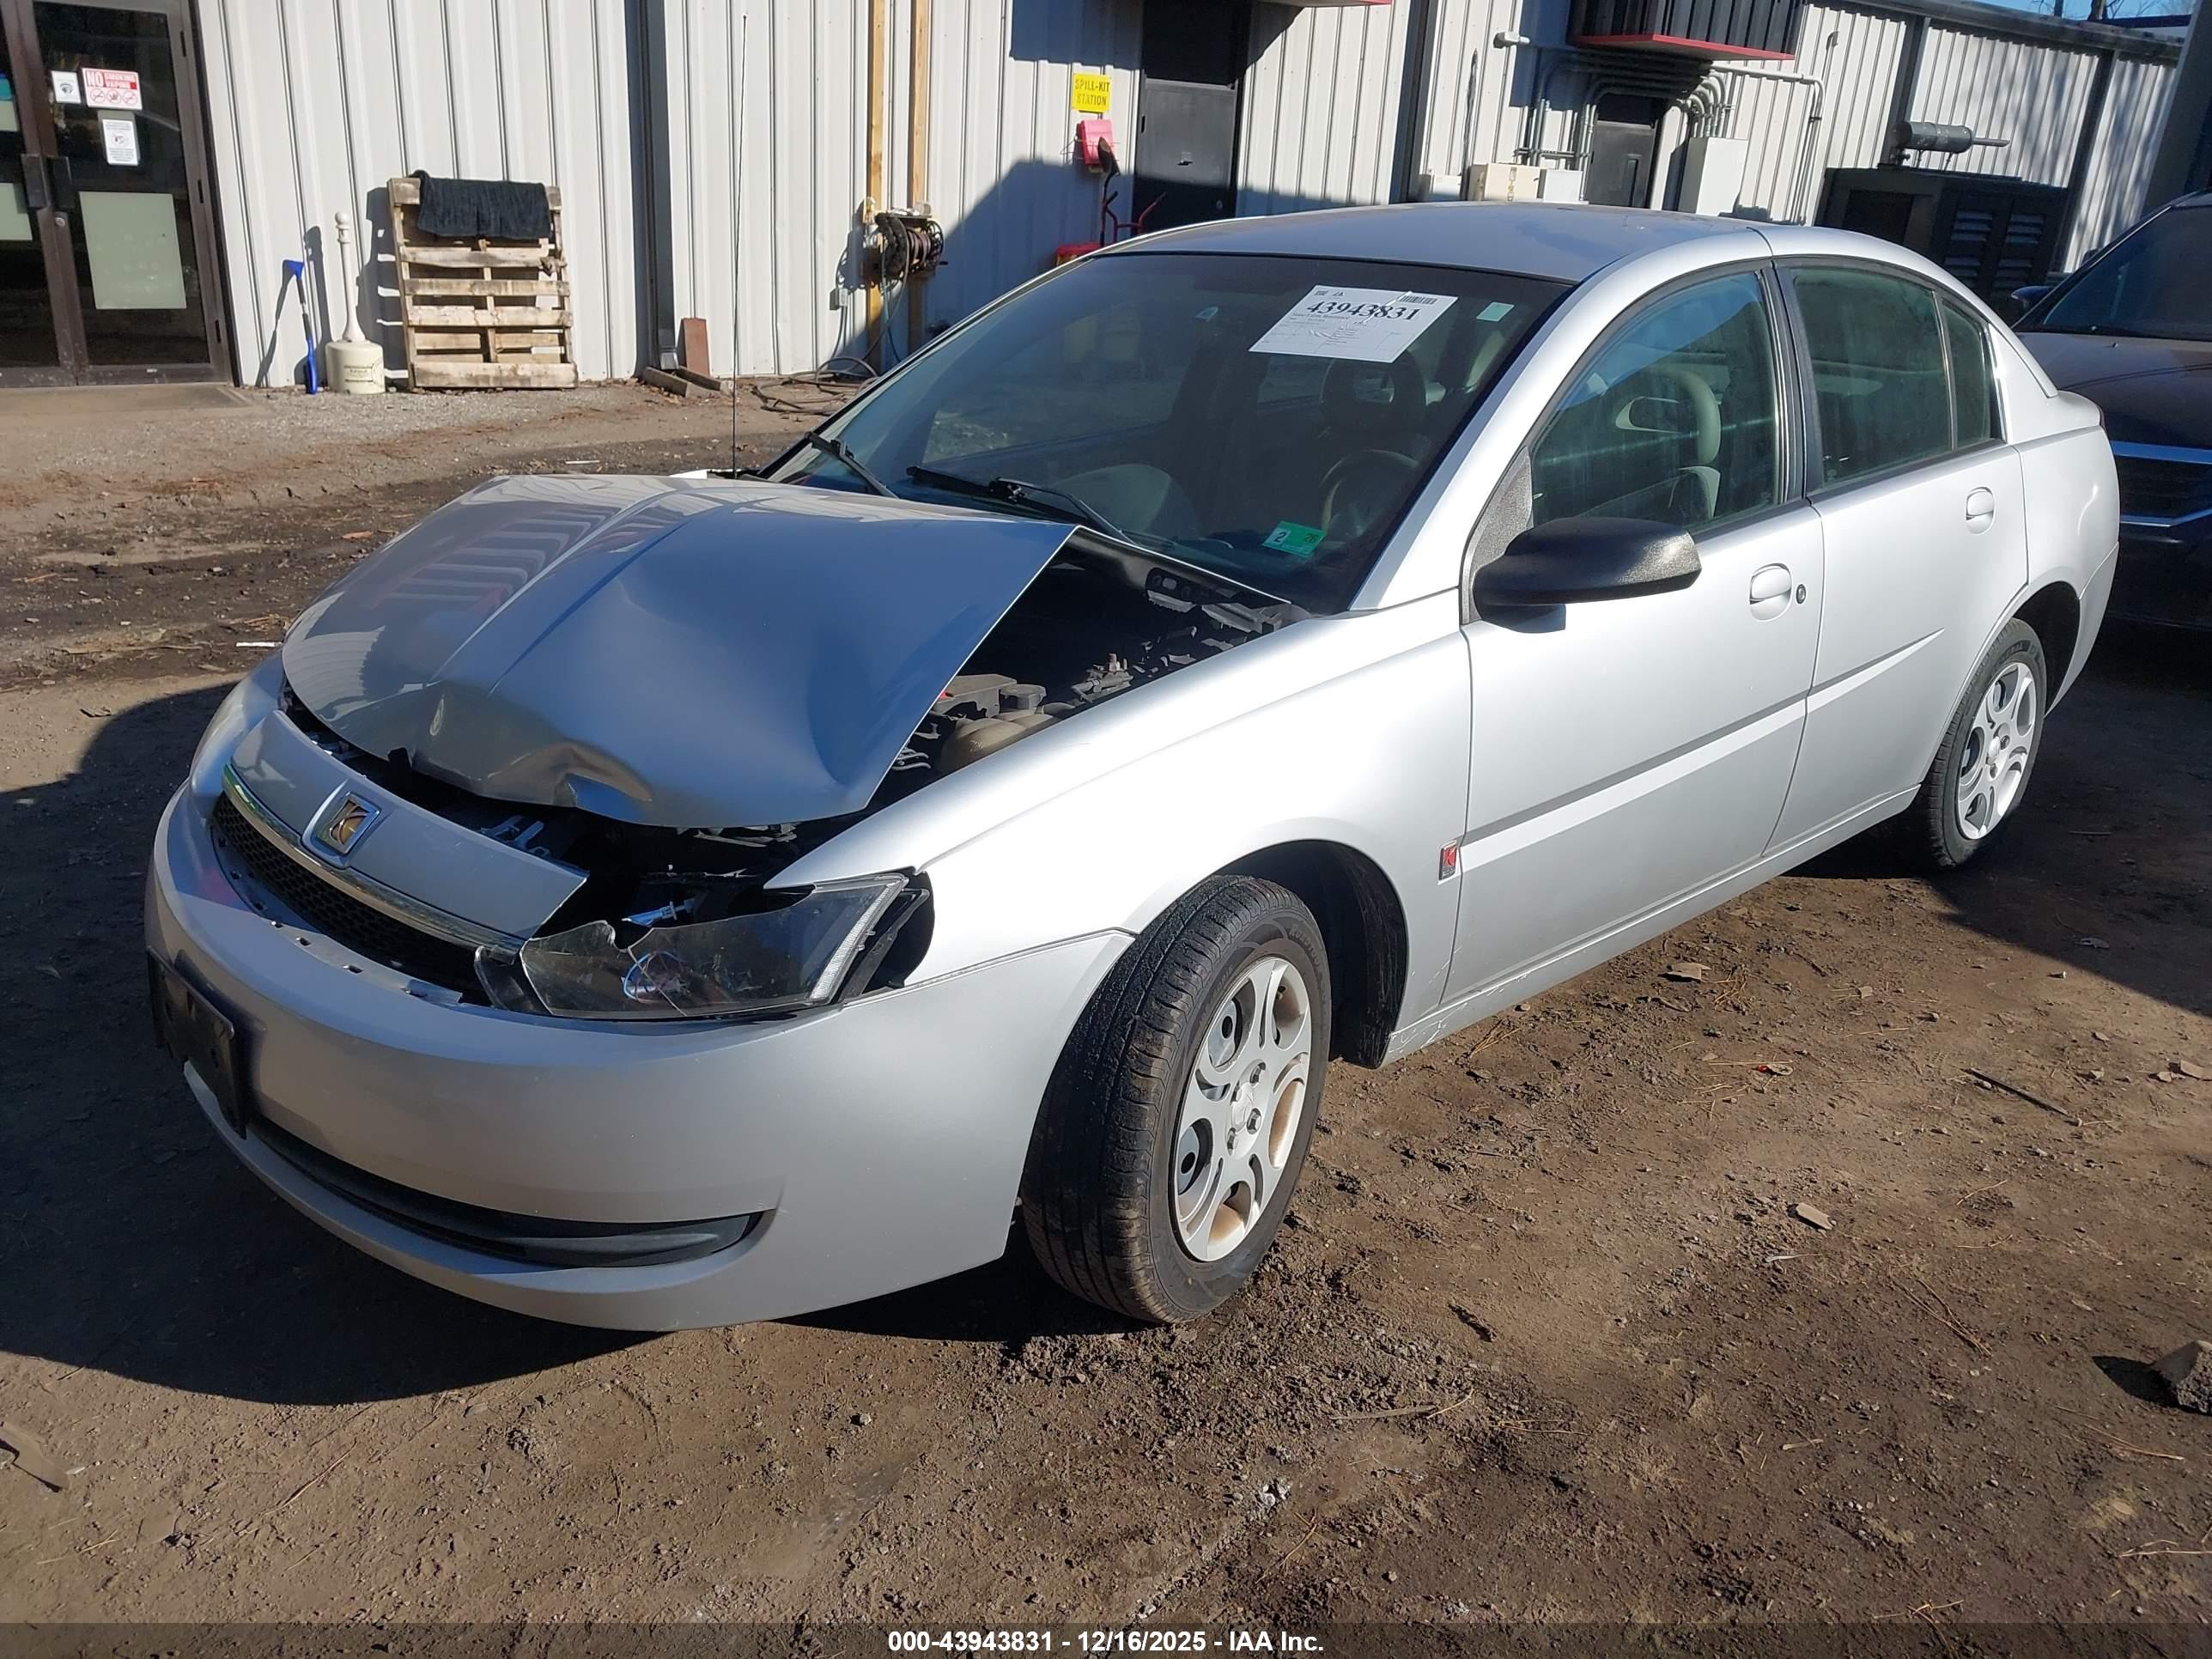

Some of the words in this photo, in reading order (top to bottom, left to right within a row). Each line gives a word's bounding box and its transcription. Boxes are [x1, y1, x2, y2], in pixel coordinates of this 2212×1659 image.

[86, 70, 104, 87] NO
[1074, 79, 1110, 92] SPILL-KIT
[1076, 94, 1107, 106] STATION
[1306, 301, 1422, 321] 43943831
[1273, 531, 1287, 544] 2
